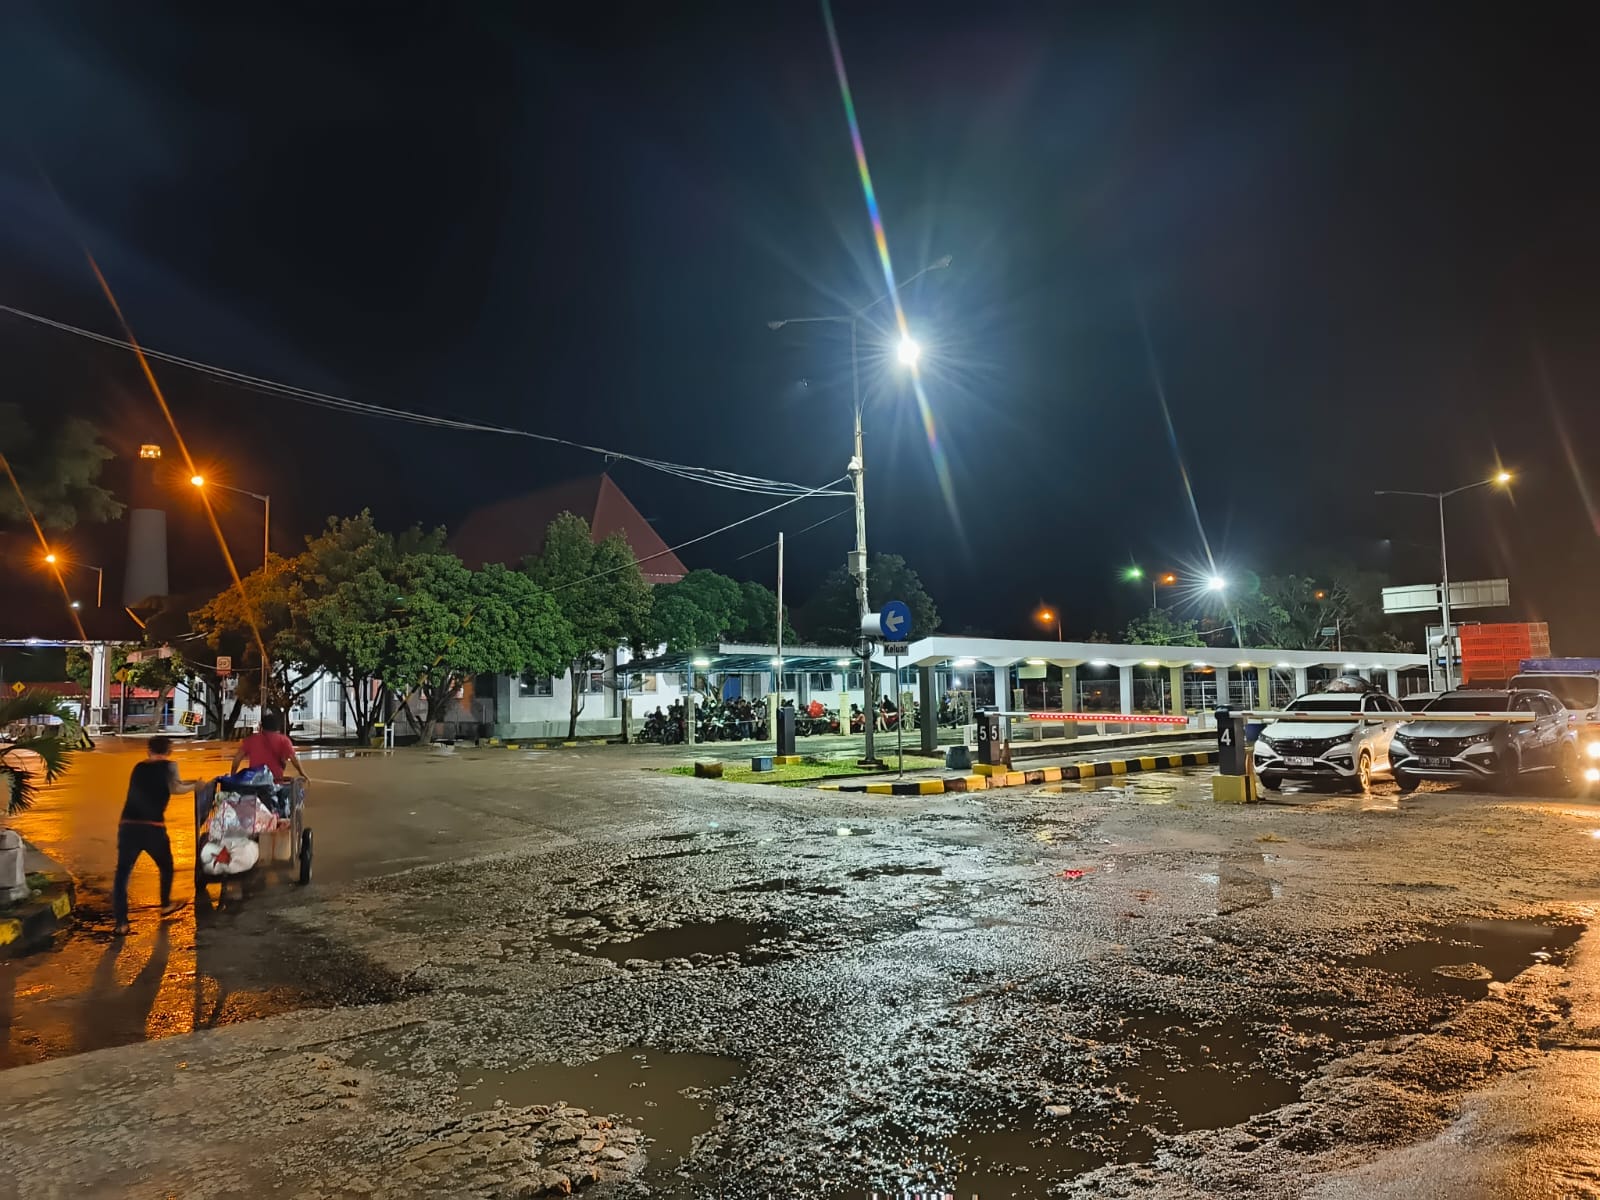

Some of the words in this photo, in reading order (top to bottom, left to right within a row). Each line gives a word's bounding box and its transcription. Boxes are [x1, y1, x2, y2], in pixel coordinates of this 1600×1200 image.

[885, 644, 908, 653] Keluar
[980, 726, 986, 740] 5
[991, 725, 998, 740] 5
[1221, 728, 1231, 746] 4
